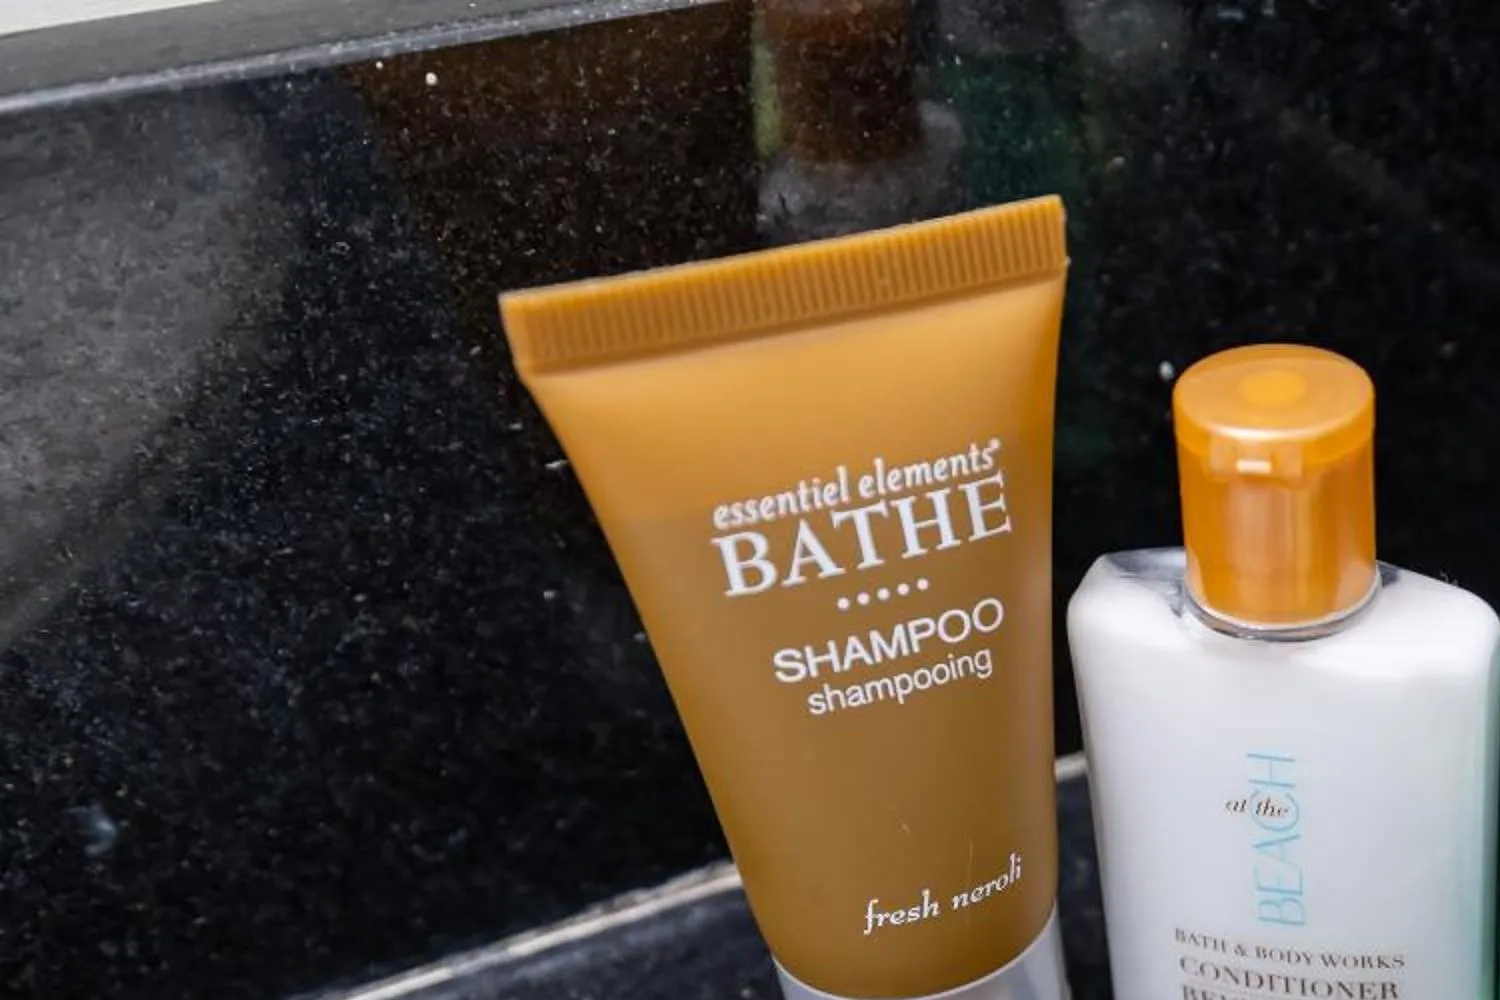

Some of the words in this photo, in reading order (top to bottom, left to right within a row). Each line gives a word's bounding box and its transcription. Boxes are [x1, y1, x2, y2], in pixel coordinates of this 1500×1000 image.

[712, 465, 849, 529] essentiel
[710, 470, 1013, 597] BATHE
[773, 598, 1004, 683] SHAMPOO
[807, 650, 993, 715] shampooing
[1225, 798, 1247, 816] at
[1255, 796, 1289, 818] the
[1245, 752, 1306, 927] BEACH
[863, 888, 940, 935] fresh
[951, 852, 1022, 910] neroli
[1175, 928, 1226, 953] BATH
[1233, 943, 1248, 958] &
[1255, 945, 1313, 967] BODY
[1321, 954, 1405, 970] WORKS
[1179, 956, 1399, 1000] CONDITIONER
